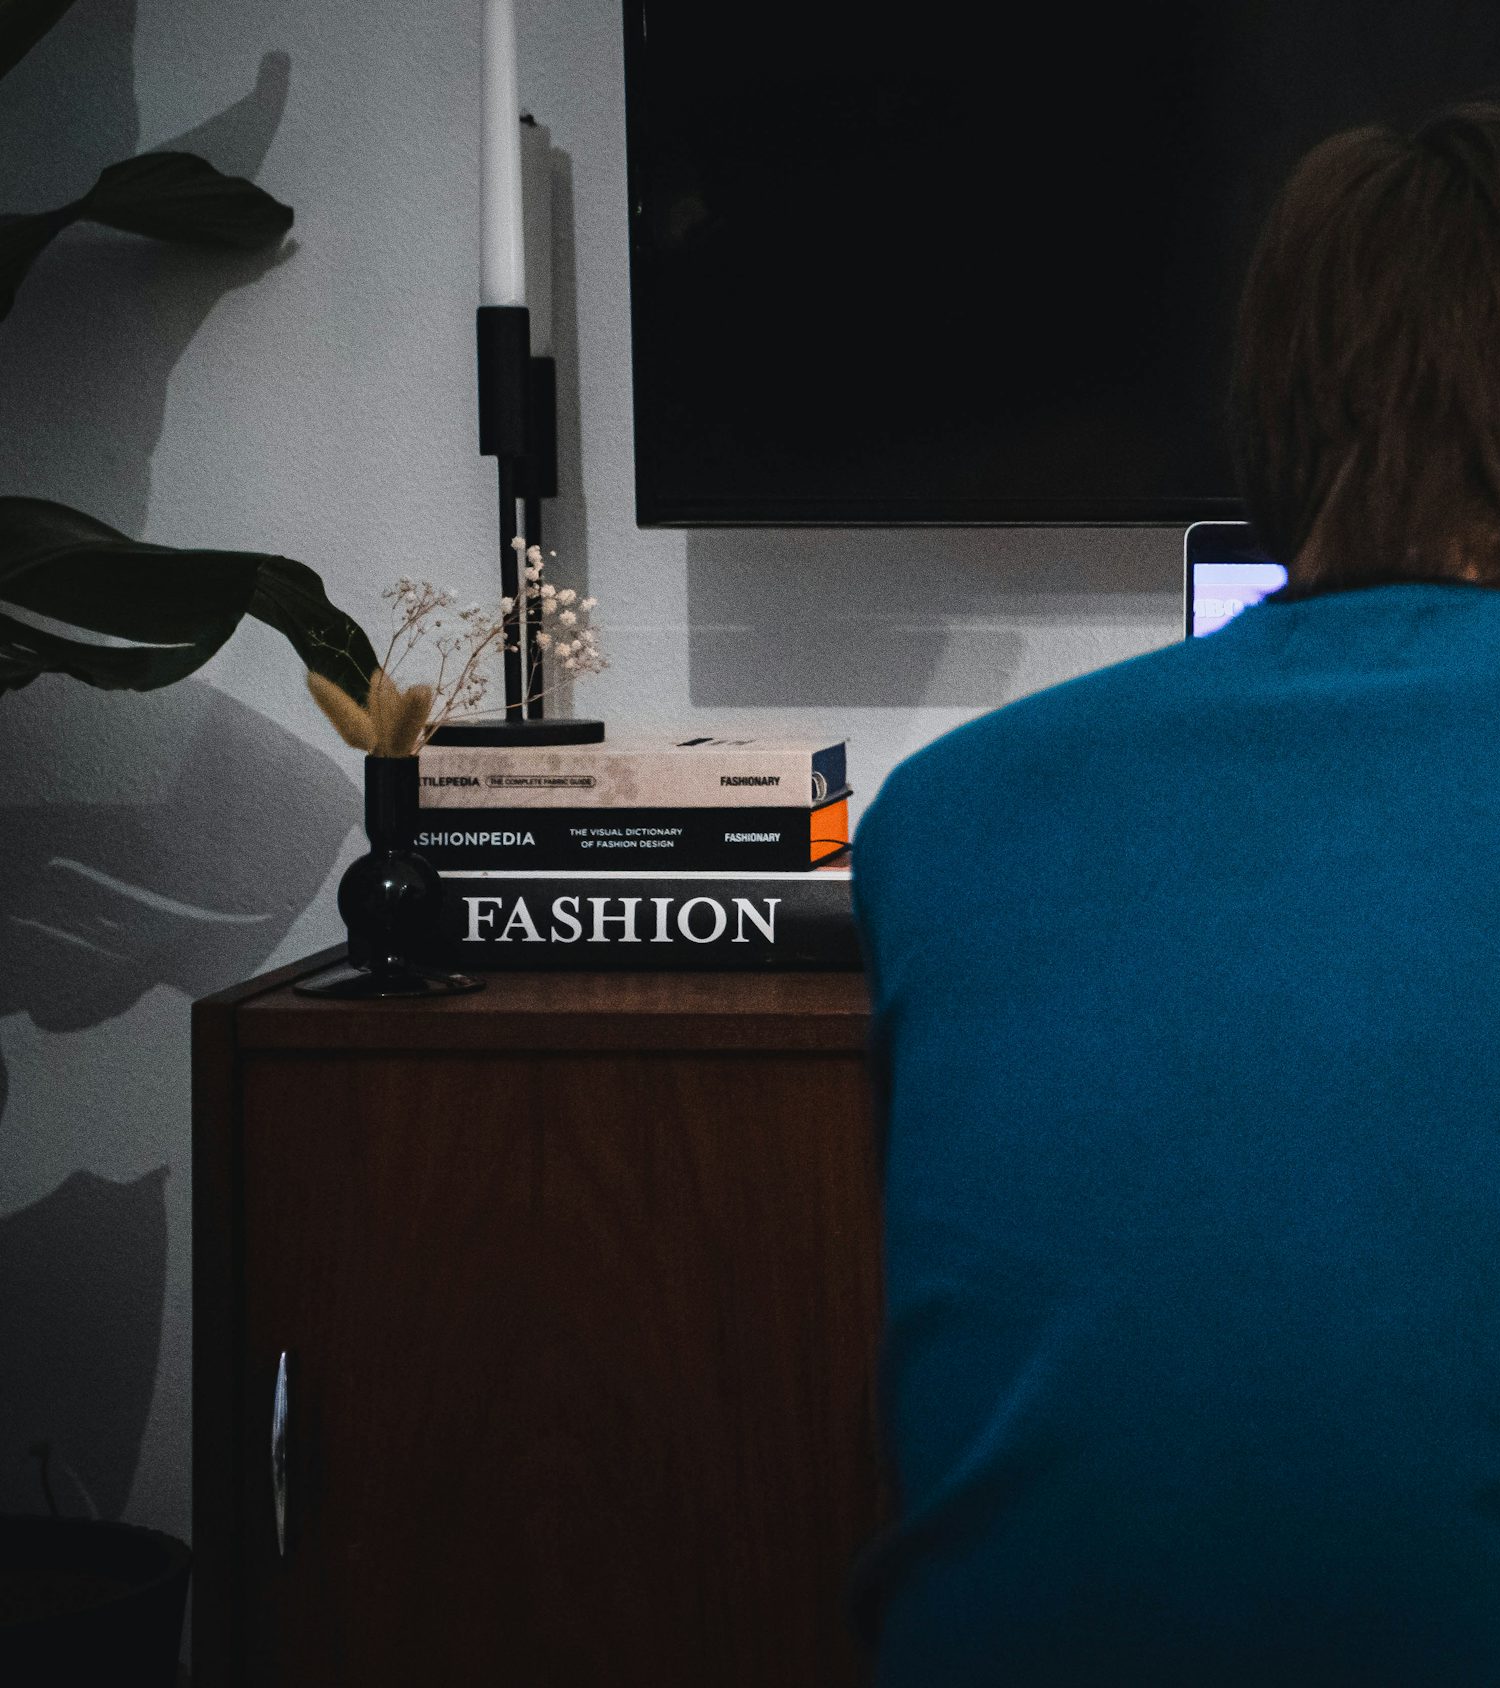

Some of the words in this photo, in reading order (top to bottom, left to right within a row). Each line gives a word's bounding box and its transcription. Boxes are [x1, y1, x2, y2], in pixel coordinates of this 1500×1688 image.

[419, 776, 481, 787] TILEPEDIA
[720, 776, 781, 787] FASHIONARY
[569, 828, 588, 837] THE
[589, 828, 624, 837] VISUAL
[625, 828, 683, 837] DICTIONARY
[724, 832, 781, 843] FASHIONARY
[580, 839, 594, 849] OF
[596, 839, 638, 849] FASHION
[639, 839, 675, 849] DESIGN
[462, 896, 782, 944] FASHION
